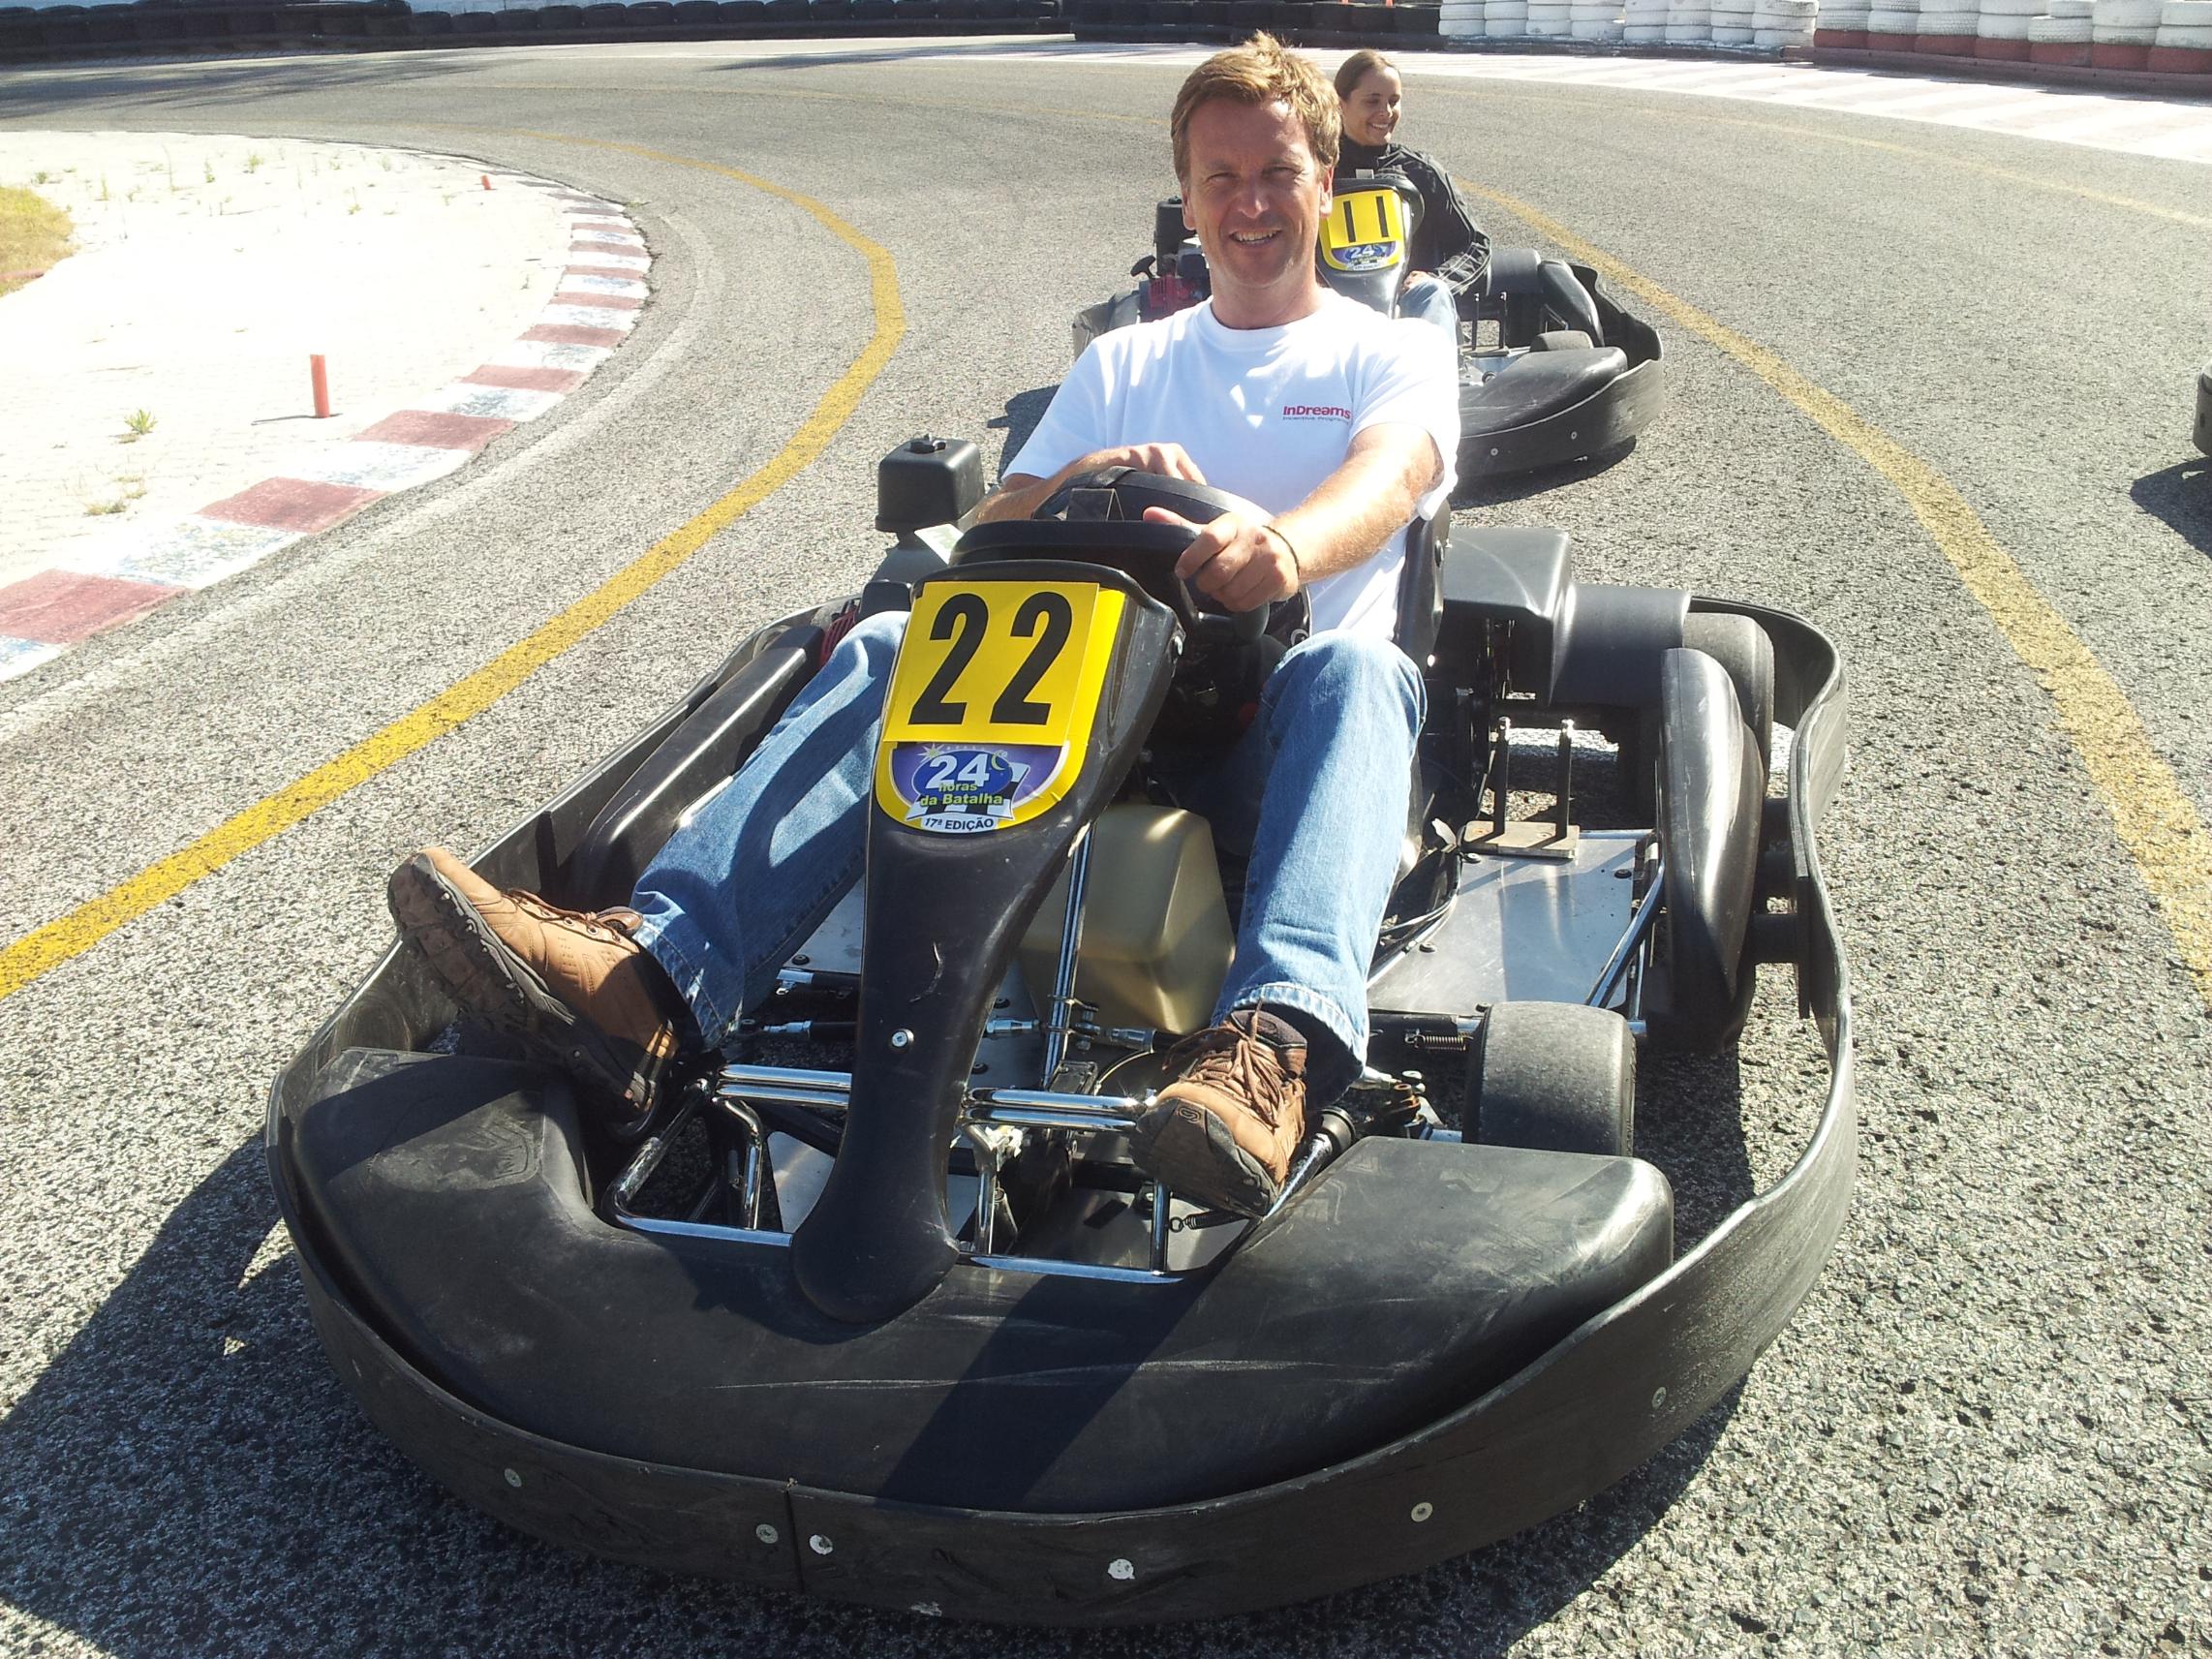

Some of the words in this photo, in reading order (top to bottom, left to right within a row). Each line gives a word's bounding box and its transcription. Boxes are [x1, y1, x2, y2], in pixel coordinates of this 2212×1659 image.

[1343, 196, 1389, 243] 11
[1350, 245, 1374, 259] 24
[1282, 405, 1351, 419] InDreams
[907, 591, 1073, 725] 22
[925, 753, 990, 788] 24
[938, 781, 978, 792] horas
[920, 794, 937, 806] da
[942, 792, 1003, 805] Batalha
[945, 816, 995, 831] EDIÇÃO
